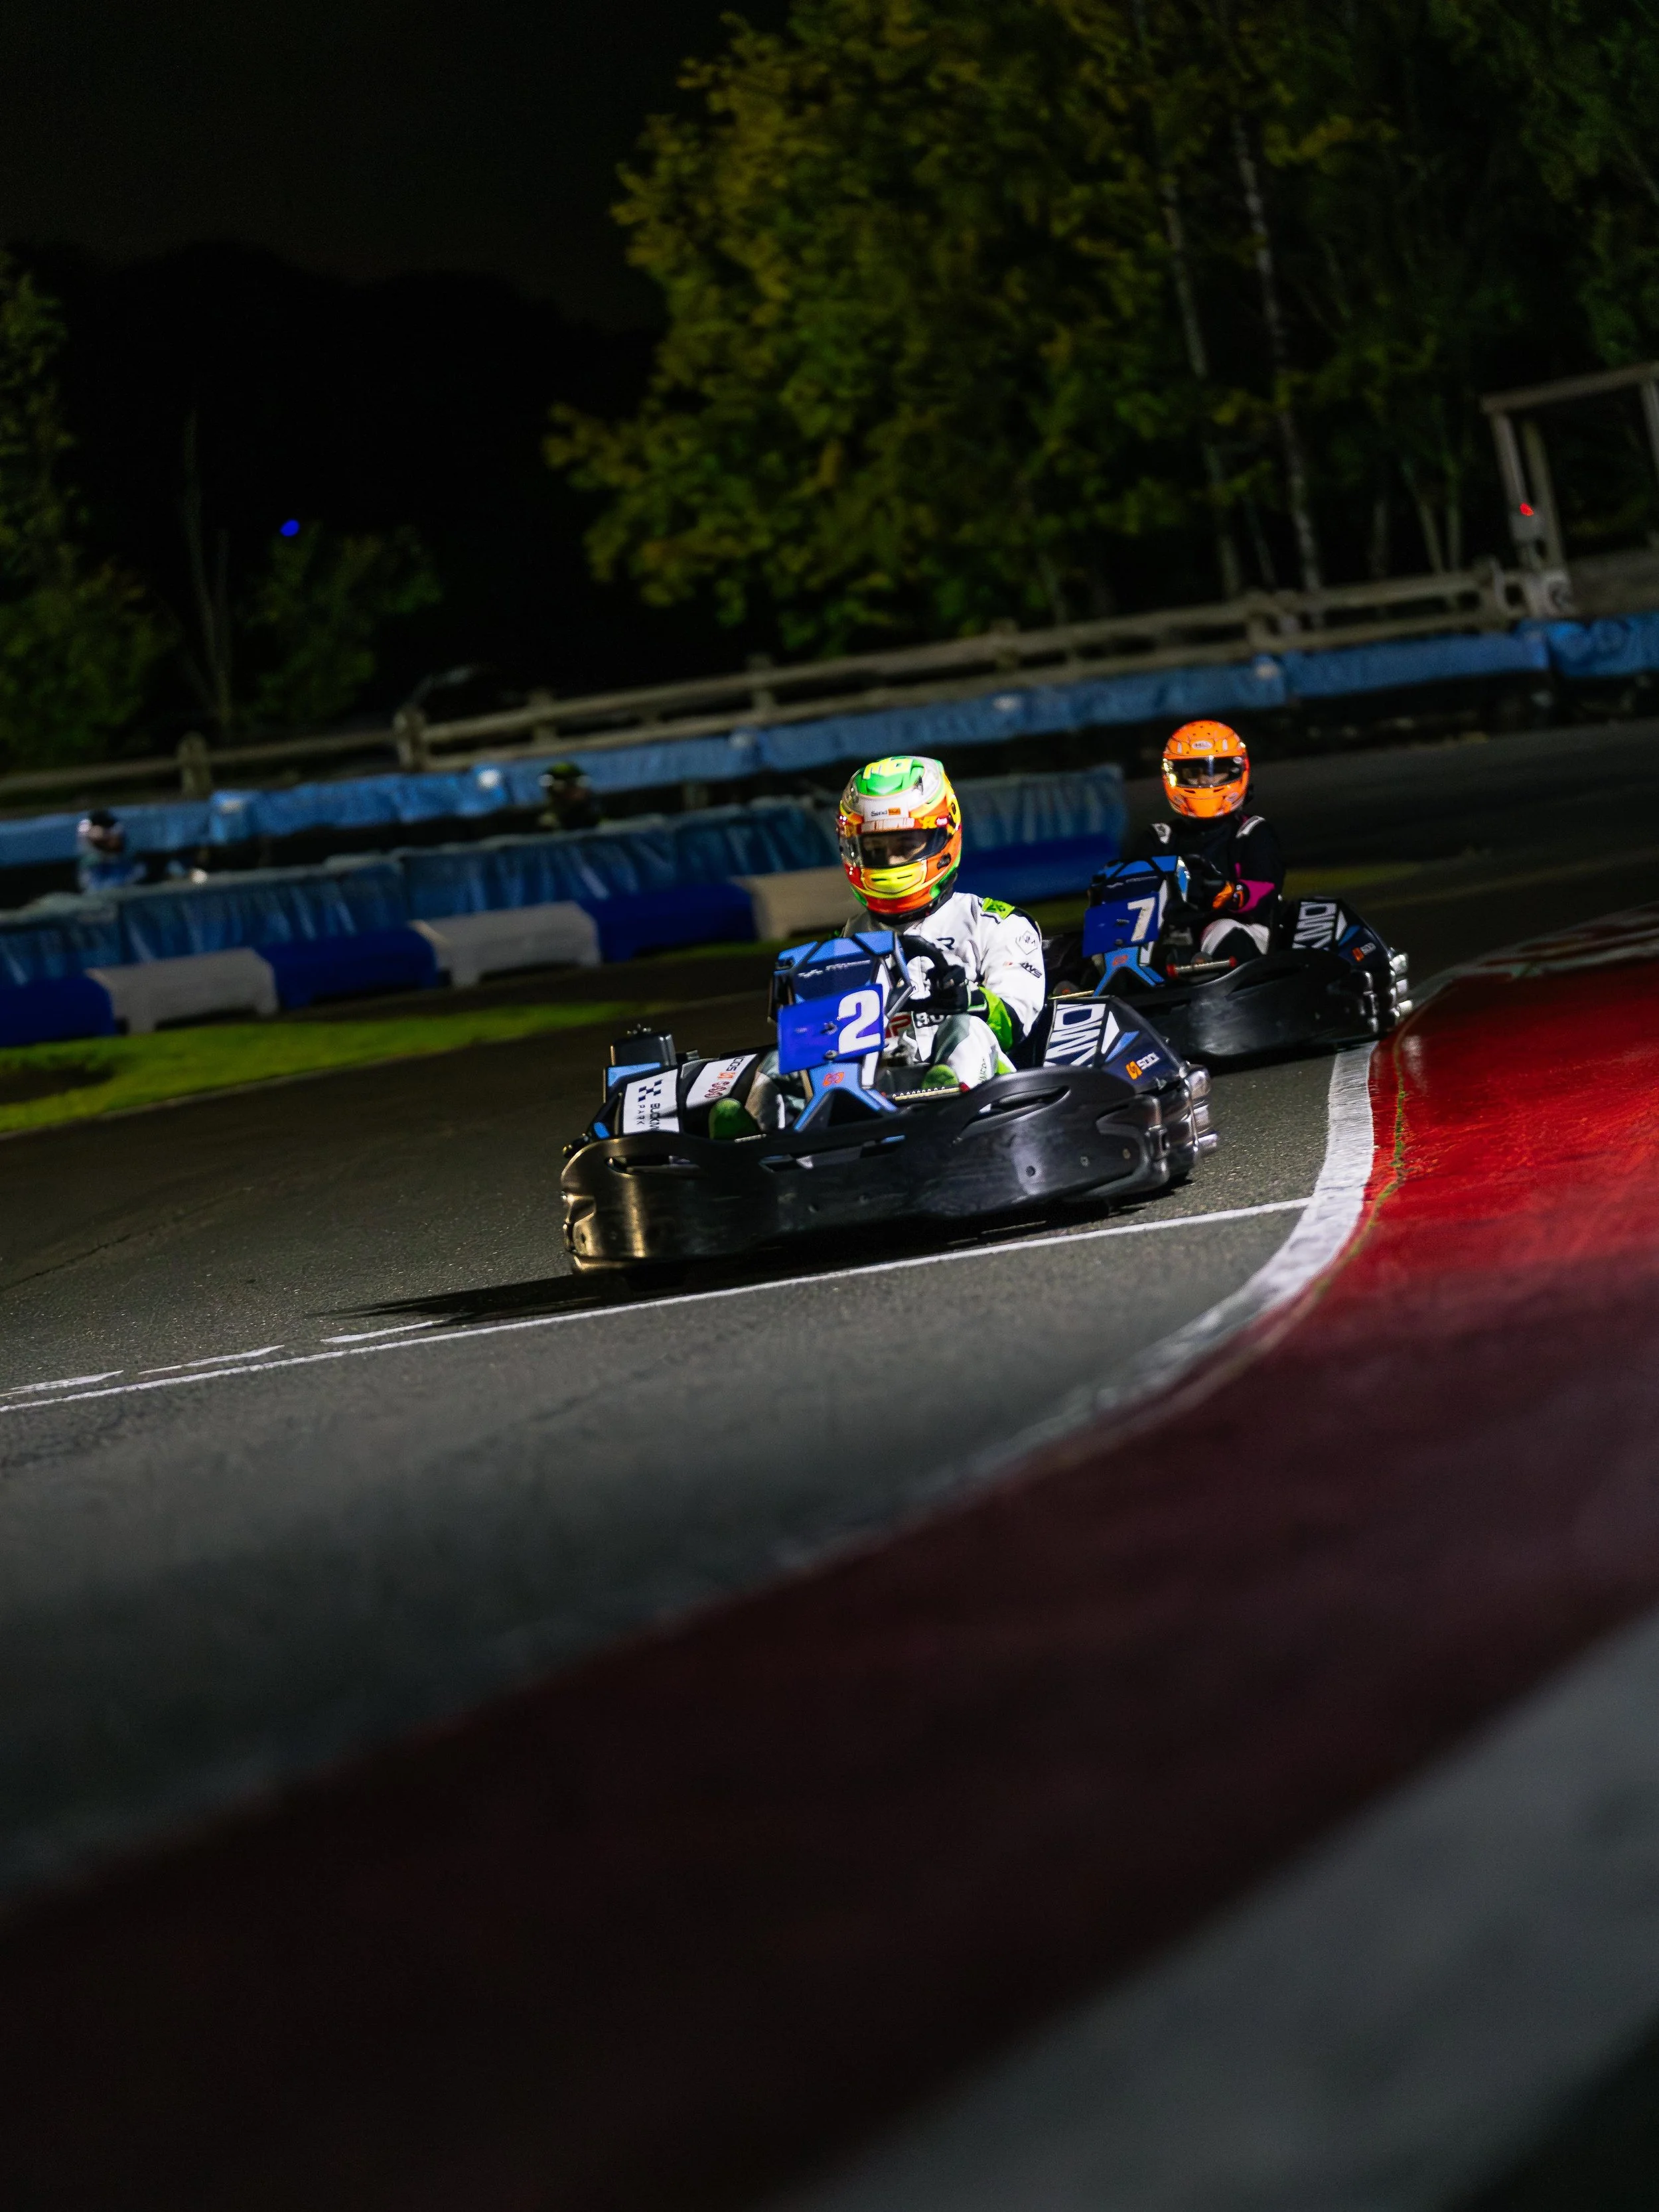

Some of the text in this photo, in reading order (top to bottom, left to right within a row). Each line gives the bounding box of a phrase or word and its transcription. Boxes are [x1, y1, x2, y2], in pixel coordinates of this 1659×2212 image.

[1127, 897, 1155, 942] 7
[839, 990, 881, 1054] 2
[636, 1104, 646, 1126] PARK
